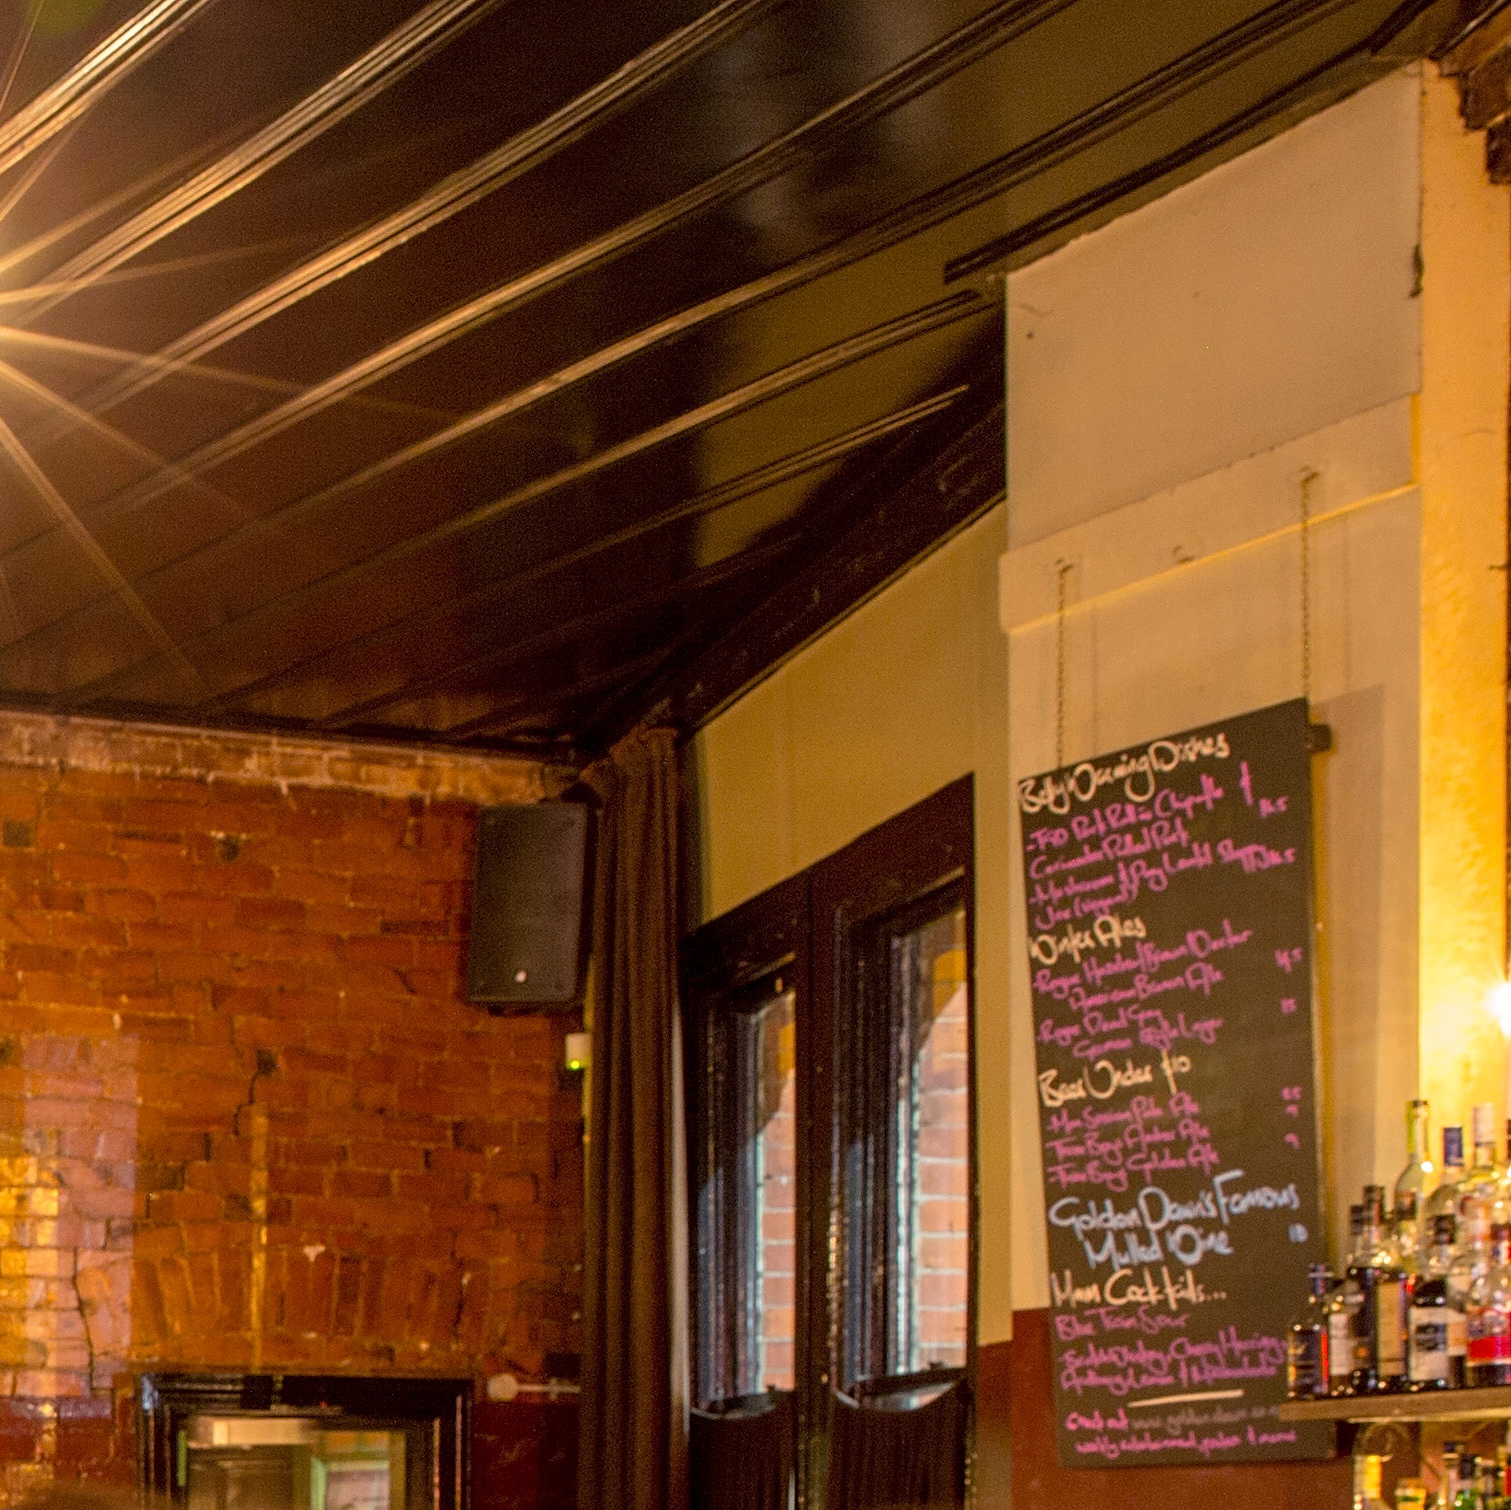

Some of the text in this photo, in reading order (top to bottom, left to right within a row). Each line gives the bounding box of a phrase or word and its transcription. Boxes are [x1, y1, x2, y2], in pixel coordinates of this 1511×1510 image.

[1148, 732, 1231, 772] Dishes
[1029, 912, 1147, 965] Winter Ales
[1083, 1060, 1153, 1099] Under
[1048, 1196, 1143, 1241] Golden
[1212, 1168, 1301, 1225] Famous
[1083, 1228, 1165, 1272] Mulled
[1166, 1223, 1234, 1267] Wine
